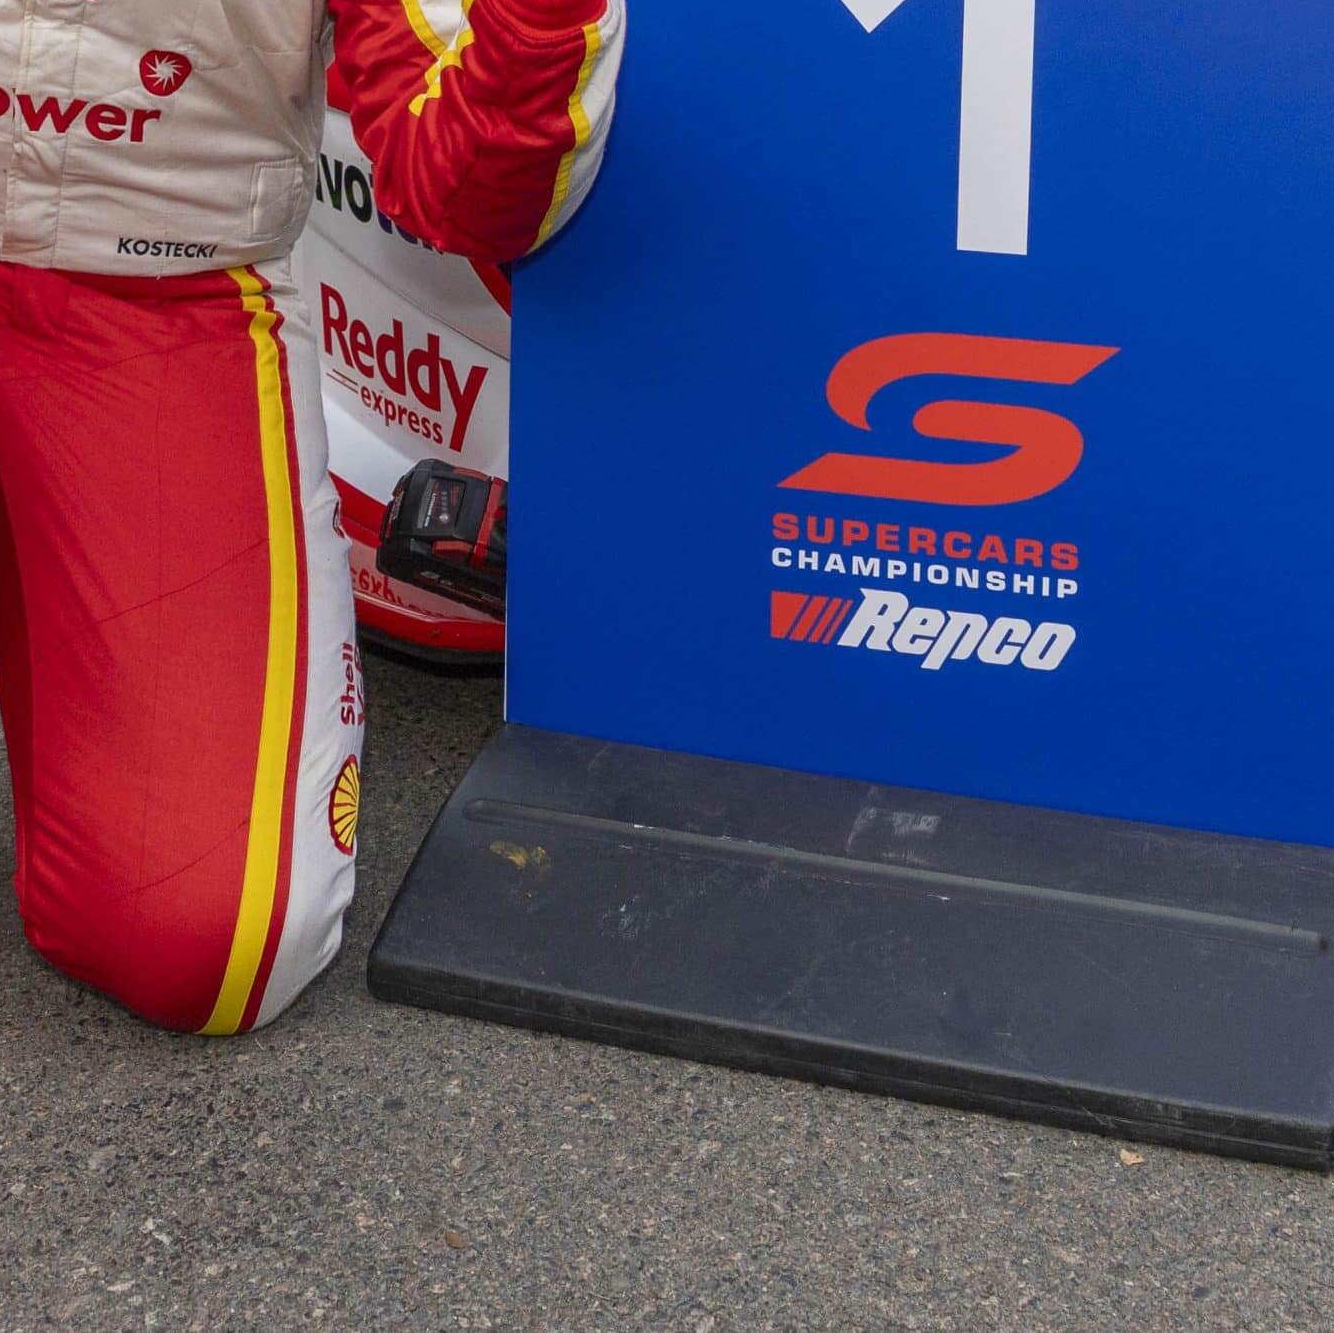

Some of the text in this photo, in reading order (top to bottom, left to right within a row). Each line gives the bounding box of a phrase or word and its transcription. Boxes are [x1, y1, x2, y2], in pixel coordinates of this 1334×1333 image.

[116, 238, 218, 260] KOSTECKI
[320, 280, 489, 453] Reddy
[361, 383, 445, 445] express
[771, 547, 1079, 599] CHAMPIONSHIP
[772, 513, 1081, 571] SUPERCARS
[836, 587, 1077, 672] Repco
[341, 642, 356, 727] Shell
